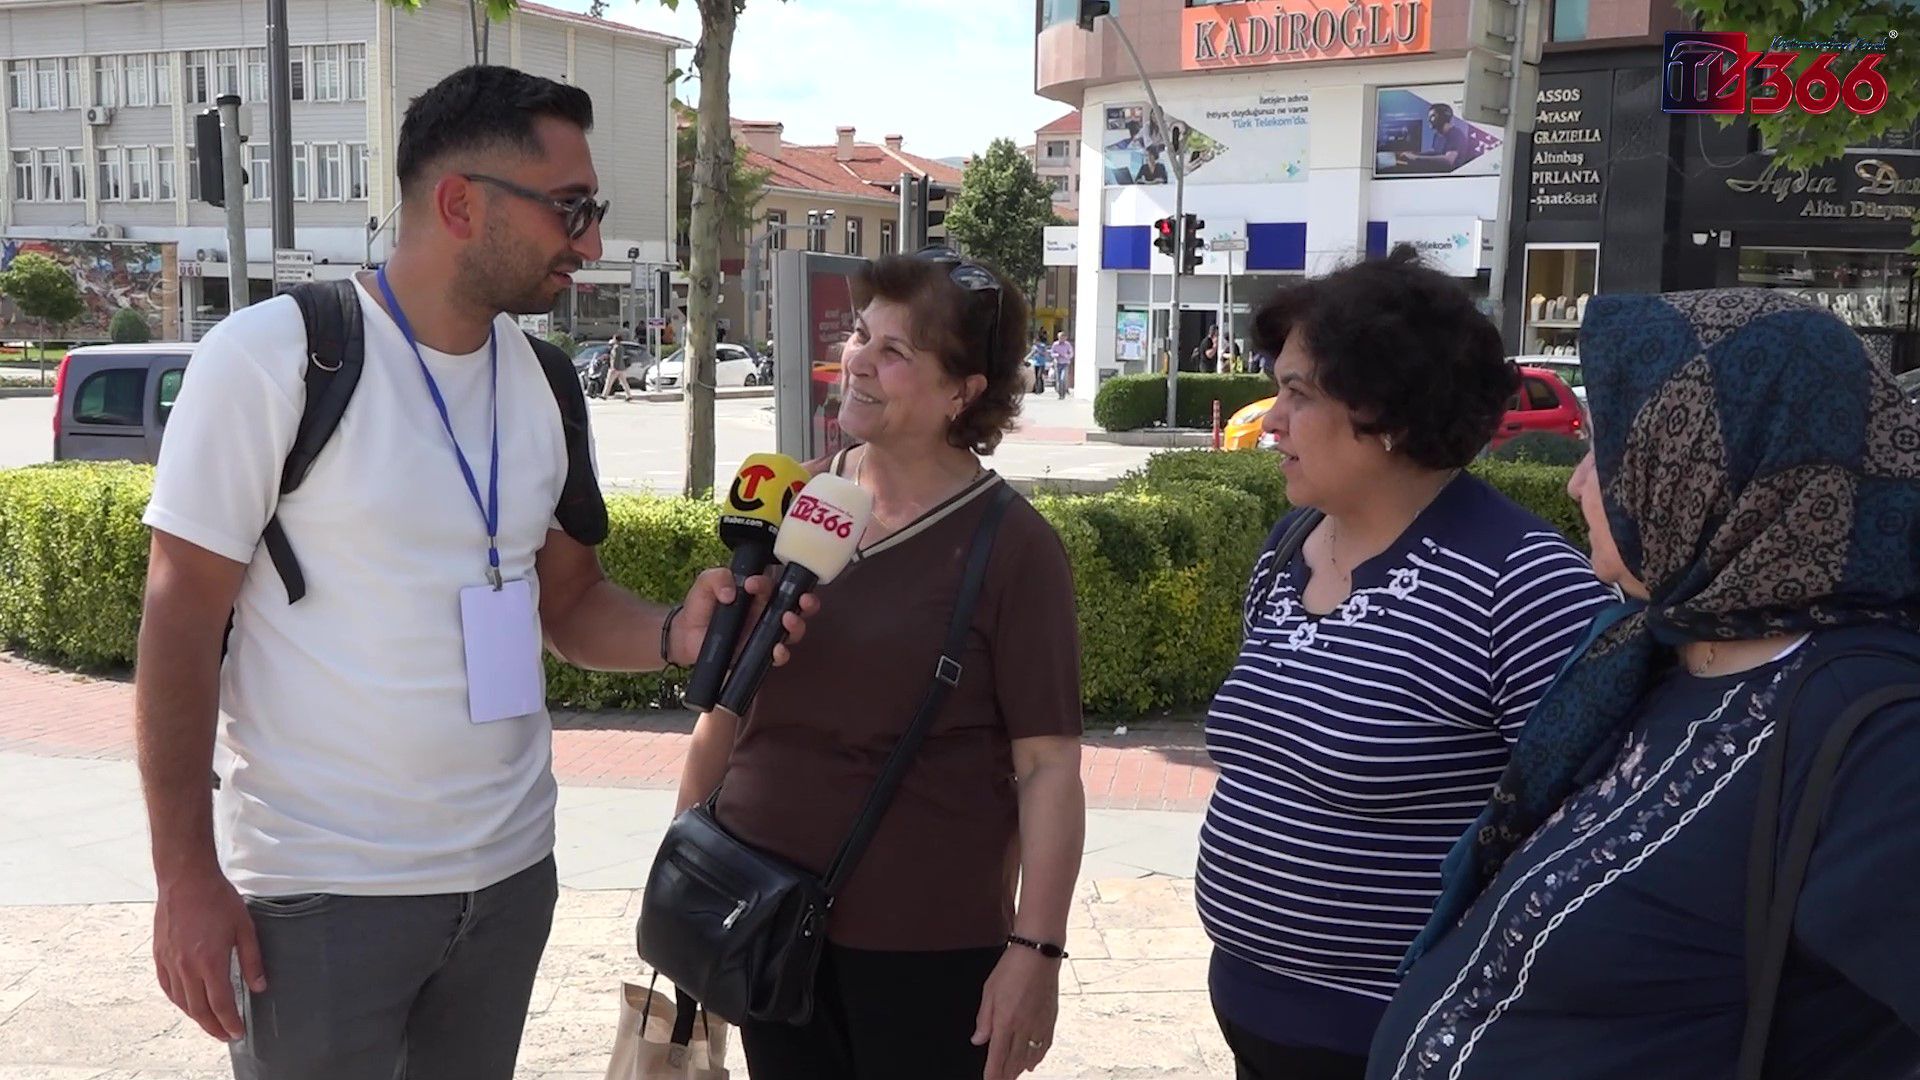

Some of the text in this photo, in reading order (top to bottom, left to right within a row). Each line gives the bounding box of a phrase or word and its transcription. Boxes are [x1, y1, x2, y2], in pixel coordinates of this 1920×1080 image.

[1194, 0, 1421, 60] KADİROĞLU
[1536, 88, 1581, 103] ASSOS
[1288, 105, 1309, 113] varsa
[1232, 118, 1252, 129] Türk
[1533, 128, 1602, 145] GRAZIELLA
[1533, 150, 1584, 166] Altınbaş
[1532, 170, 1600, 185] PIRLANTA
[1535, 190, 1599, 205] saat&saat
[1800, 200, 1846, 218] Altın
[1415, 240, 1453, 250] Telekom
